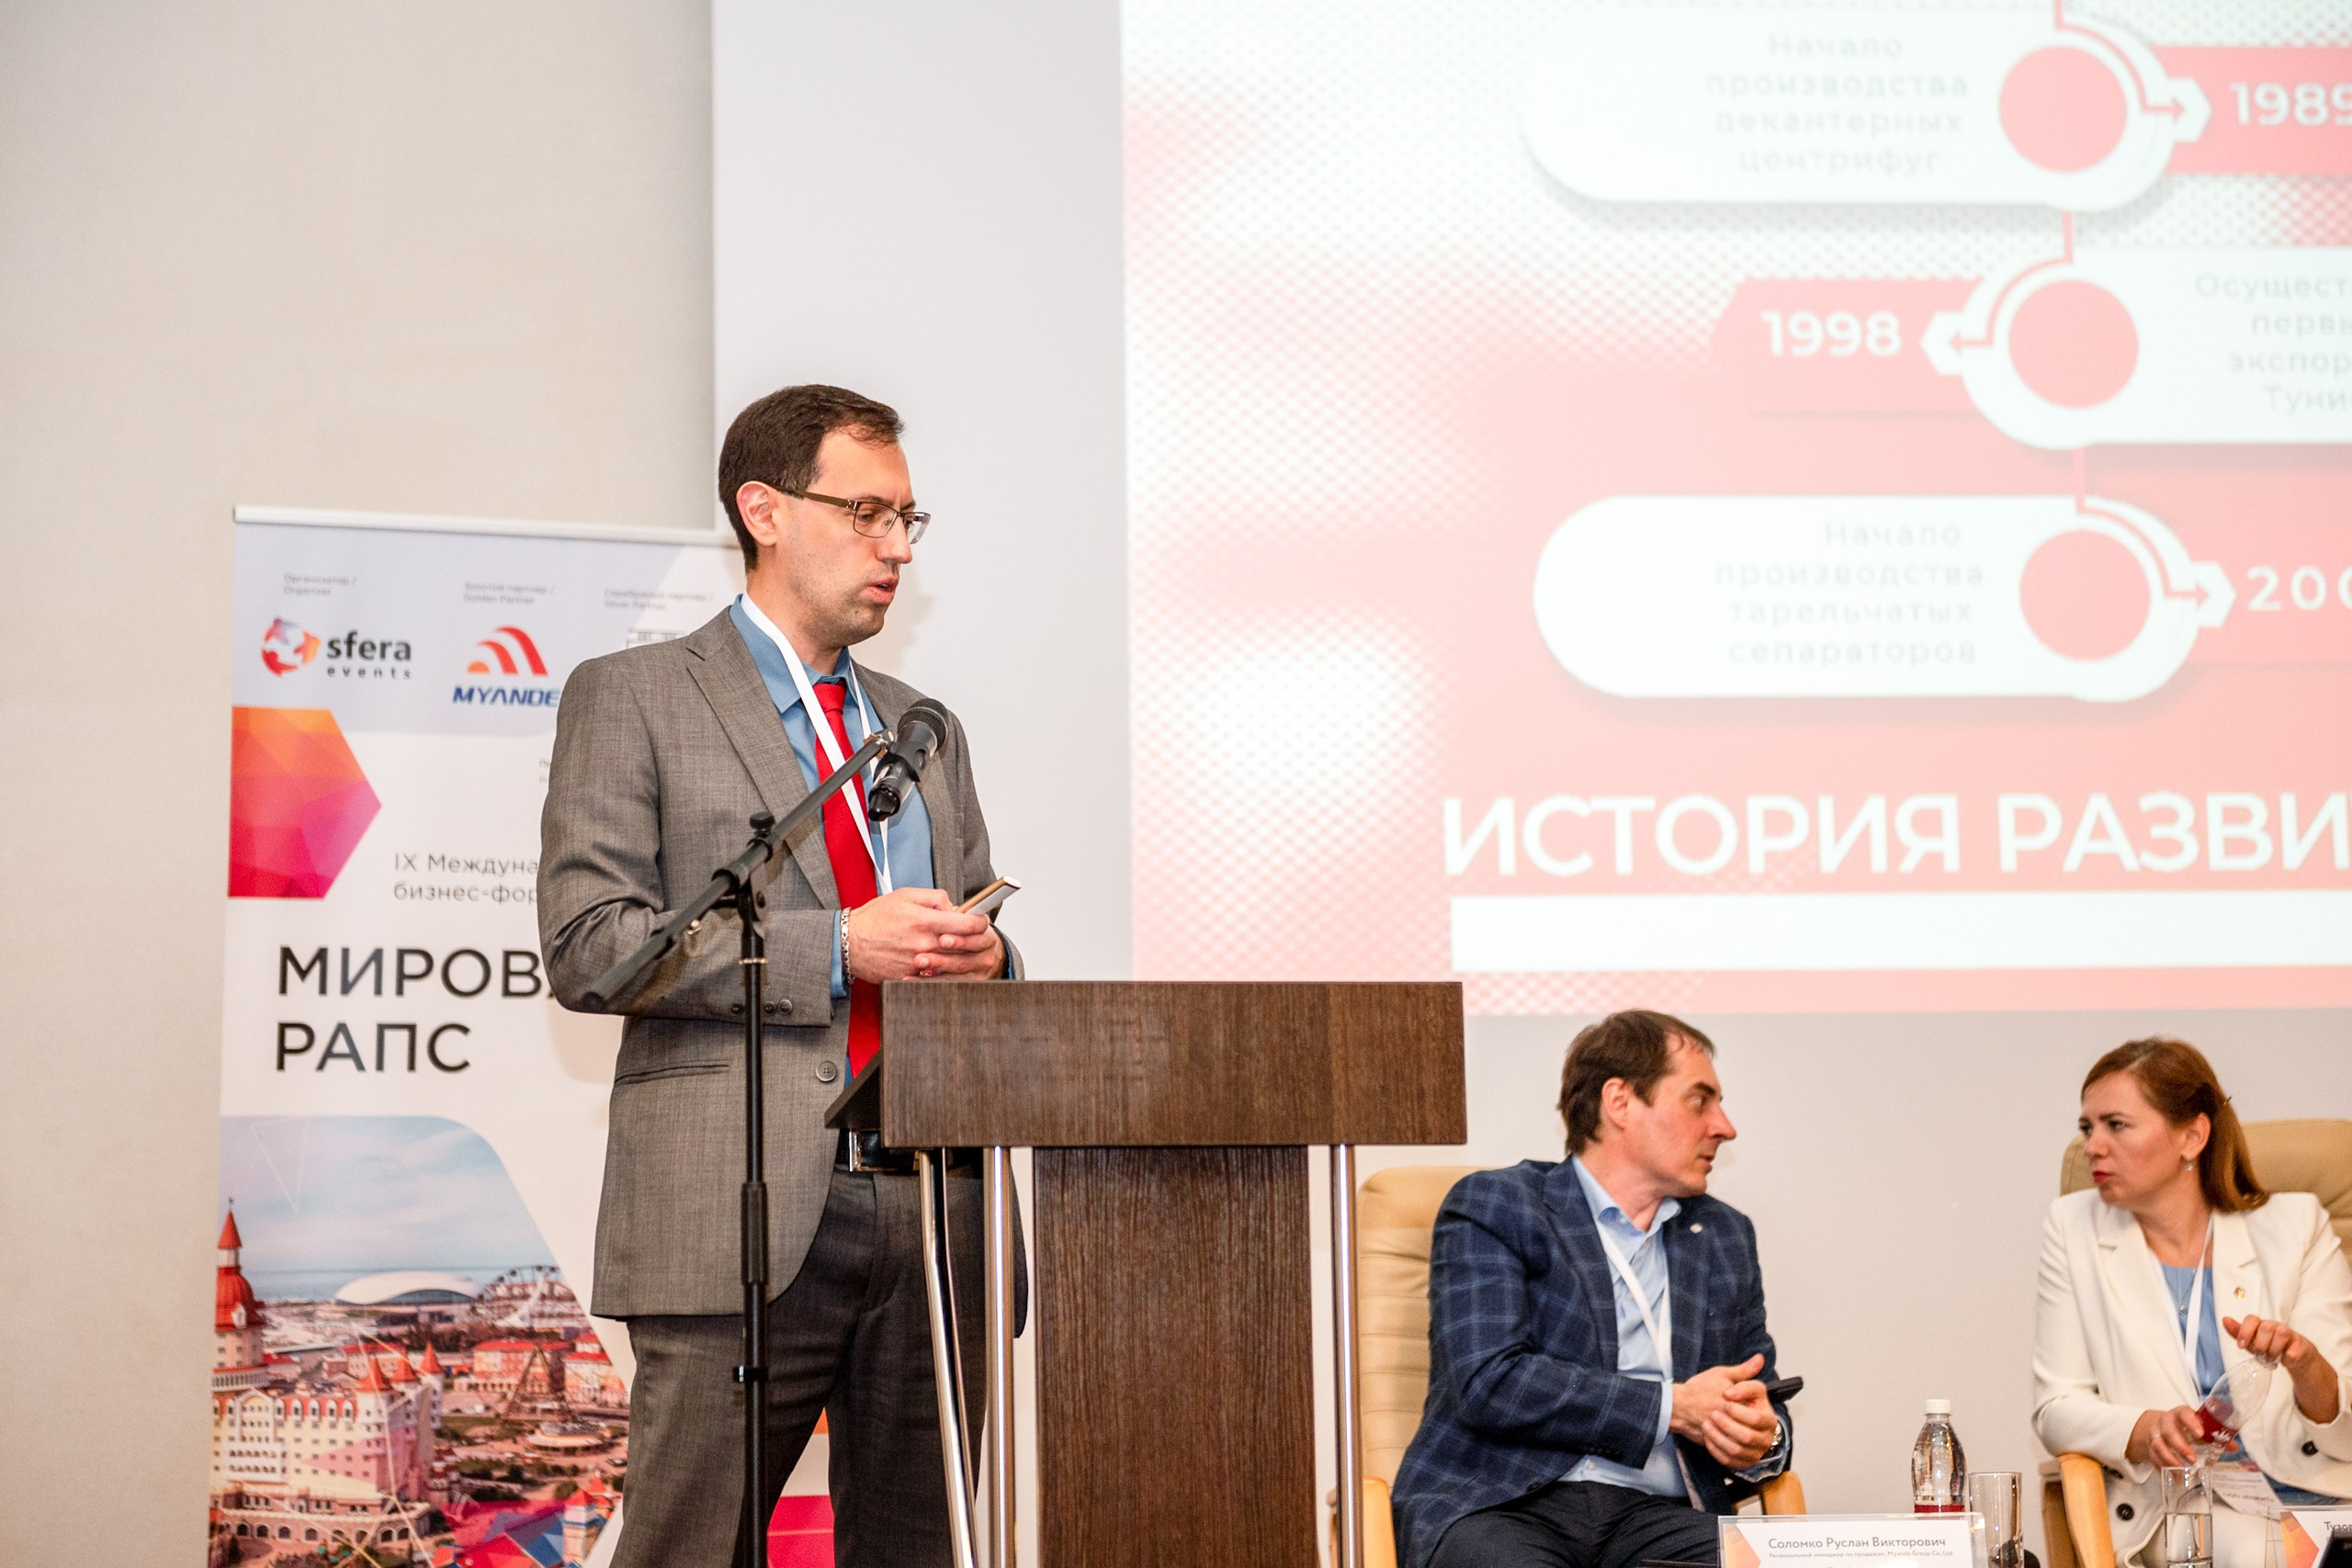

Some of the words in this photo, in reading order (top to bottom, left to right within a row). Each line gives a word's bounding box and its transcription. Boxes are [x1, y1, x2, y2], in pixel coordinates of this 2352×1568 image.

[1768, 32, 1904, 59] Начало
[1705, 73, 1969, 100] производства
[2229, 81, 2352, 126] 1989
[1714, 111, 1964, 138] декантерных
[1738, 147, 1940, 178] центрифуг
[2195, 272, 2352, 304] Осущест
[1760, 310, 1902, 357] 1998
[2263, 382, 2352, 417] Туни
[1824, 519, 1962, 547] Начало
[1713, 562, 1984, 591] производства
[1728, 601, 1973, 629] тарельчатых
[326, 629, 412, 661] sfera
[1727, 640, 1976, 670] сепараторов
[327, 666, 412, 680] events
[452, 684, 561, 707] MYANDE
[1442, 793, 1961, 877] ИСТОРИЯ
[1997, 790, 2351, 874] РАЗВИ
[394, 853, 418, 873] IX
[278, 945, 555, 998] МИРОВ
[276, 1021, 472, 1073] РАПС
[1768, 1538, 1823, 1550] Соломко
[1826, 1537, 1869, 1551] Руслан
[1872, 1536, 1946, 1550] Викторович
